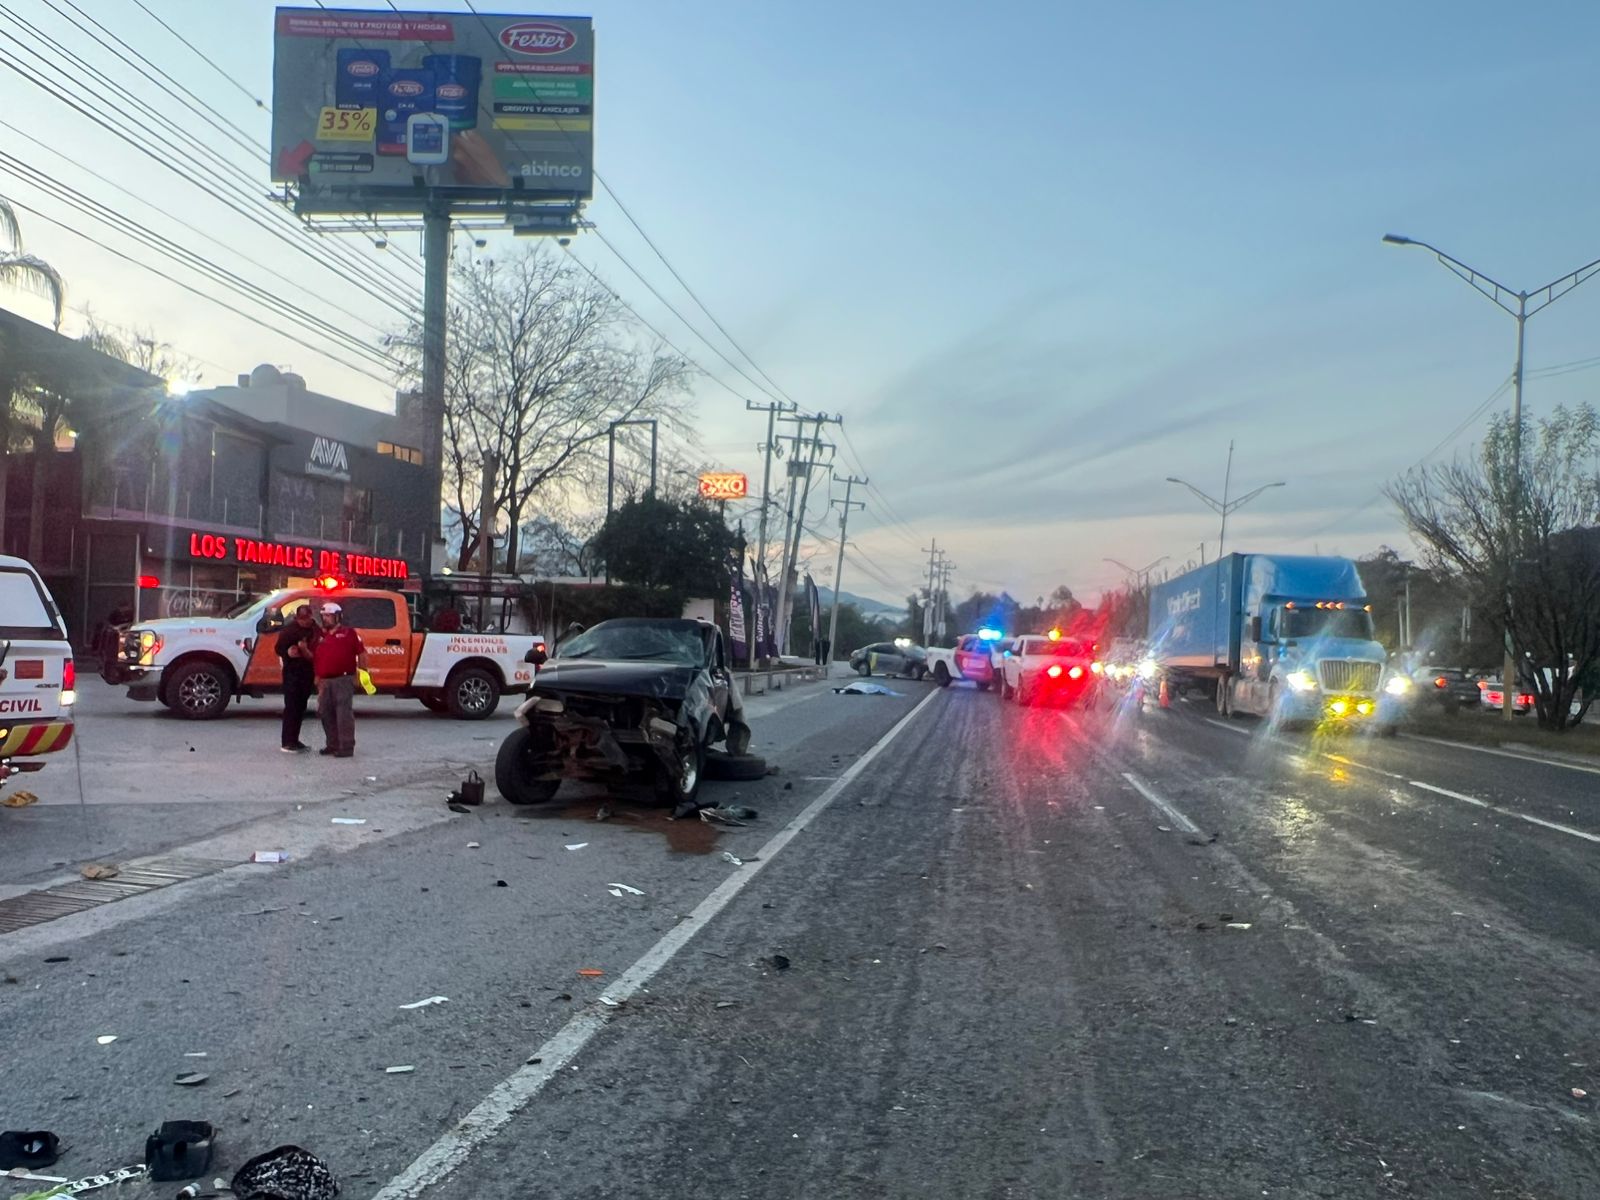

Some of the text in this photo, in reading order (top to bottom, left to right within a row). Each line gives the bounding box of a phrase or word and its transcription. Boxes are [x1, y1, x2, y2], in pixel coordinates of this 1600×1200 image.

[508, 28, 566, 49] Fester
[322, 111, 370, 131] 35%
[520, 160, 582, 177] abinco
[310, 436, 348, 471] AVA
[190, 532, 407, 578] LOS TAMALES DE TERESITA
[450, 636, 505, 645] INCENDIOS
[364, 645, 405, 655] ECCIÓN
[446, 645, 508, 654] FORESTALES
[514, 670, 531, 681] 06
[0, 699, 42, 713] CIVIL
